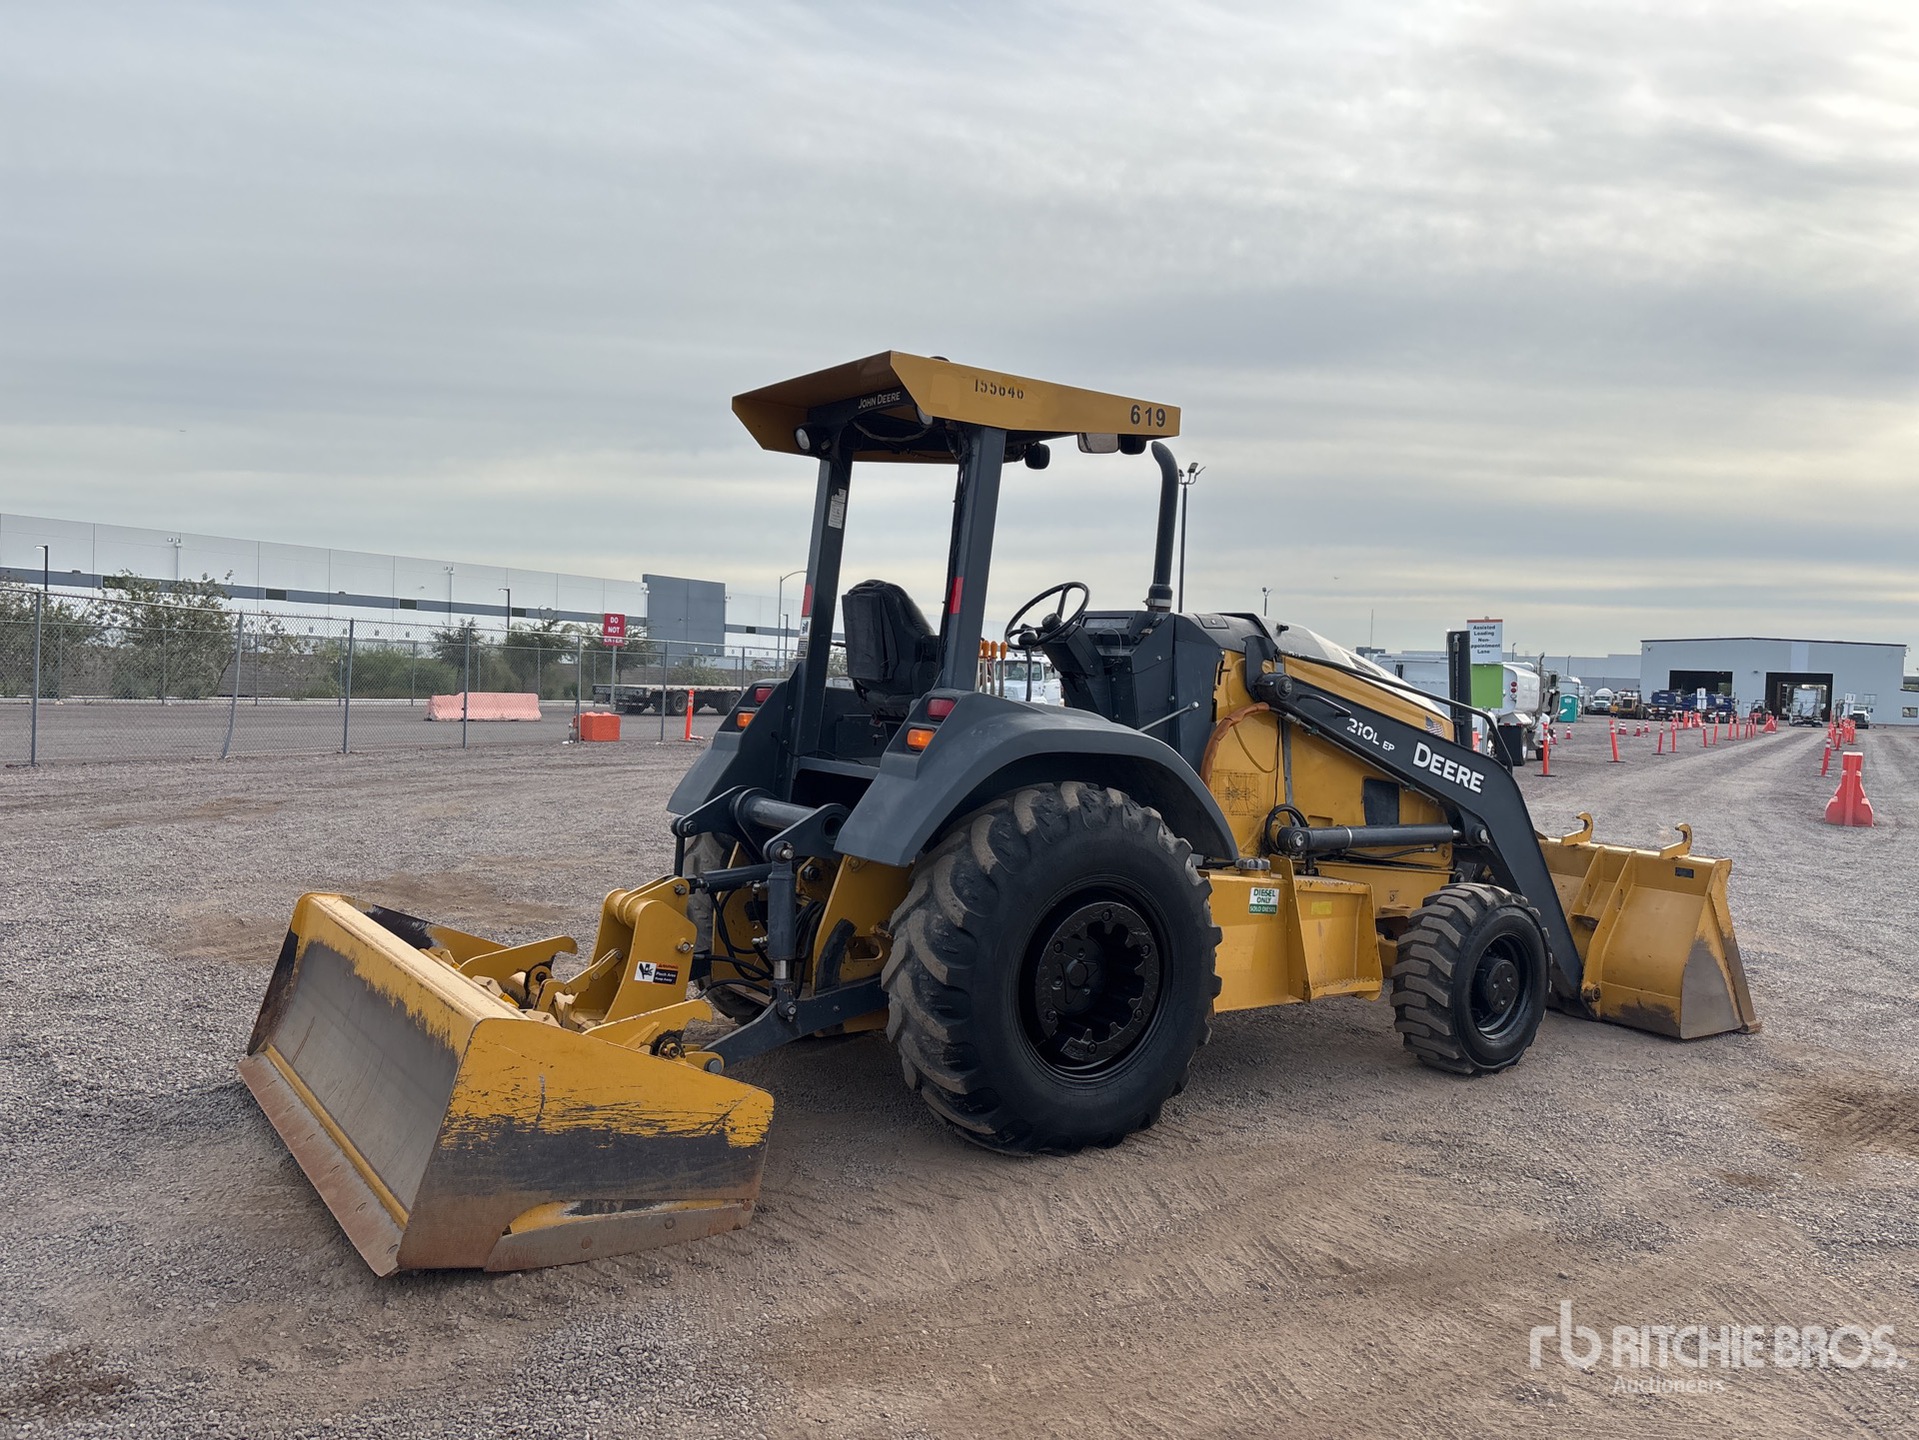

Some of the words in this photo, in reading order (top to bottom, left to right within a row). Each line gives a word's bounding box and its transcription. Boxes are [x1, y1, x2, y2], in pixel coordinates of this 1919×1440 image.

[858, 397, 877, 410] JOHN
[877, 391, 901, 406] DEERE
[1130, 404, 1166, 428] 619
[610, 616, 619, 624] DO
[607, 626, 620, 634] NOT
[1346, 718, 1380, 746] 210L
[1382, 740, 1395, 752] EP
[1412, 741, 1485, 794] DEERE
[1253, 888, 1276, 897] DIESEL
[1256, 896, 1272, 904] ONLY
